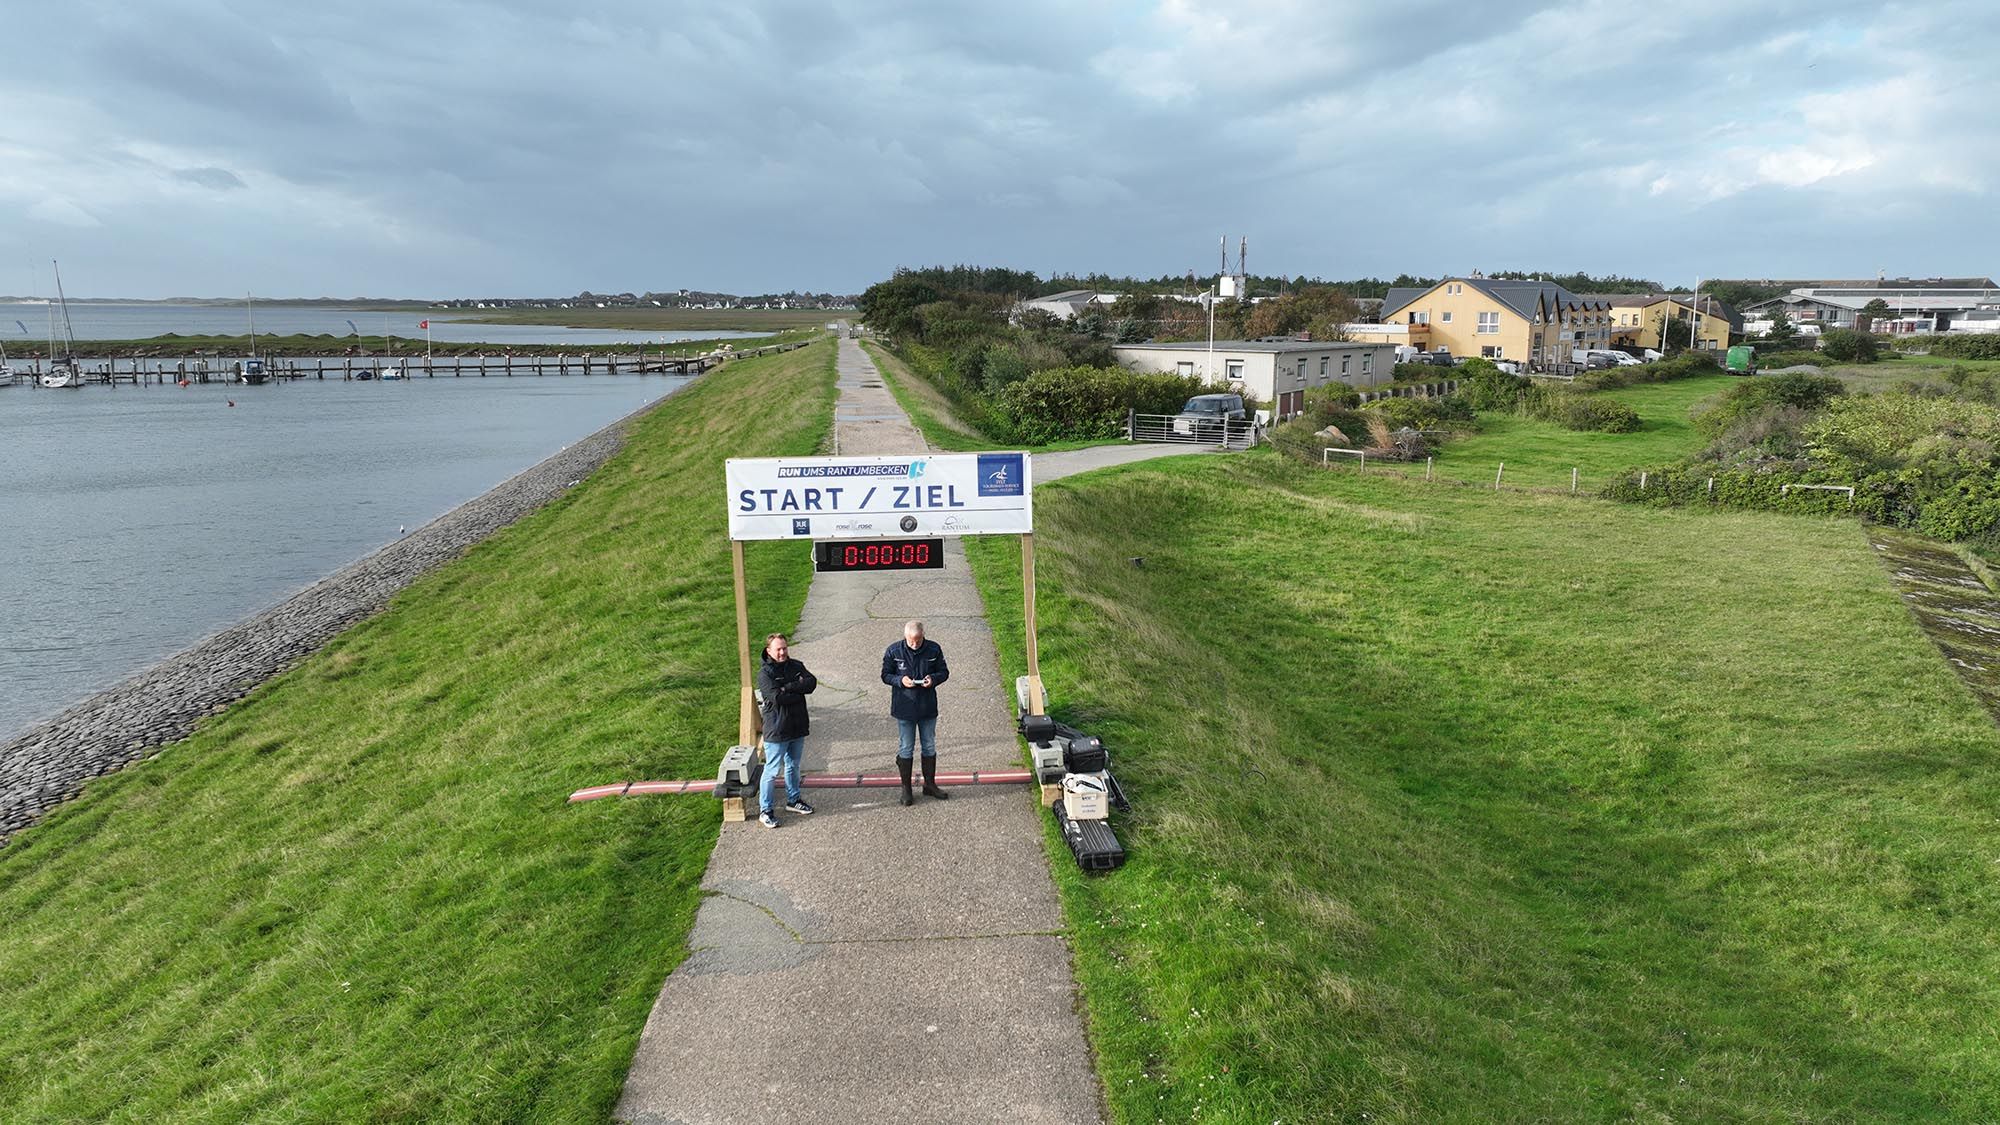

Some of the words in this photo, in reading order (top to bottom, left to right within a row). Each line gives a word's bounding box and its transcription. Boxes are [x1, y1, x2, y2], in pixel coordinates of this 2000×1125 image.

[779, 468, 801, 477] RUN
[802, 467, 825, 476] UMS
[827, 465, 908, 476] RANTUMBECKEN
[740, 487, 844, 512] START
[893, 485, 965, 509] ZIEL
[844, 544, 929, 566] 0:00:00
